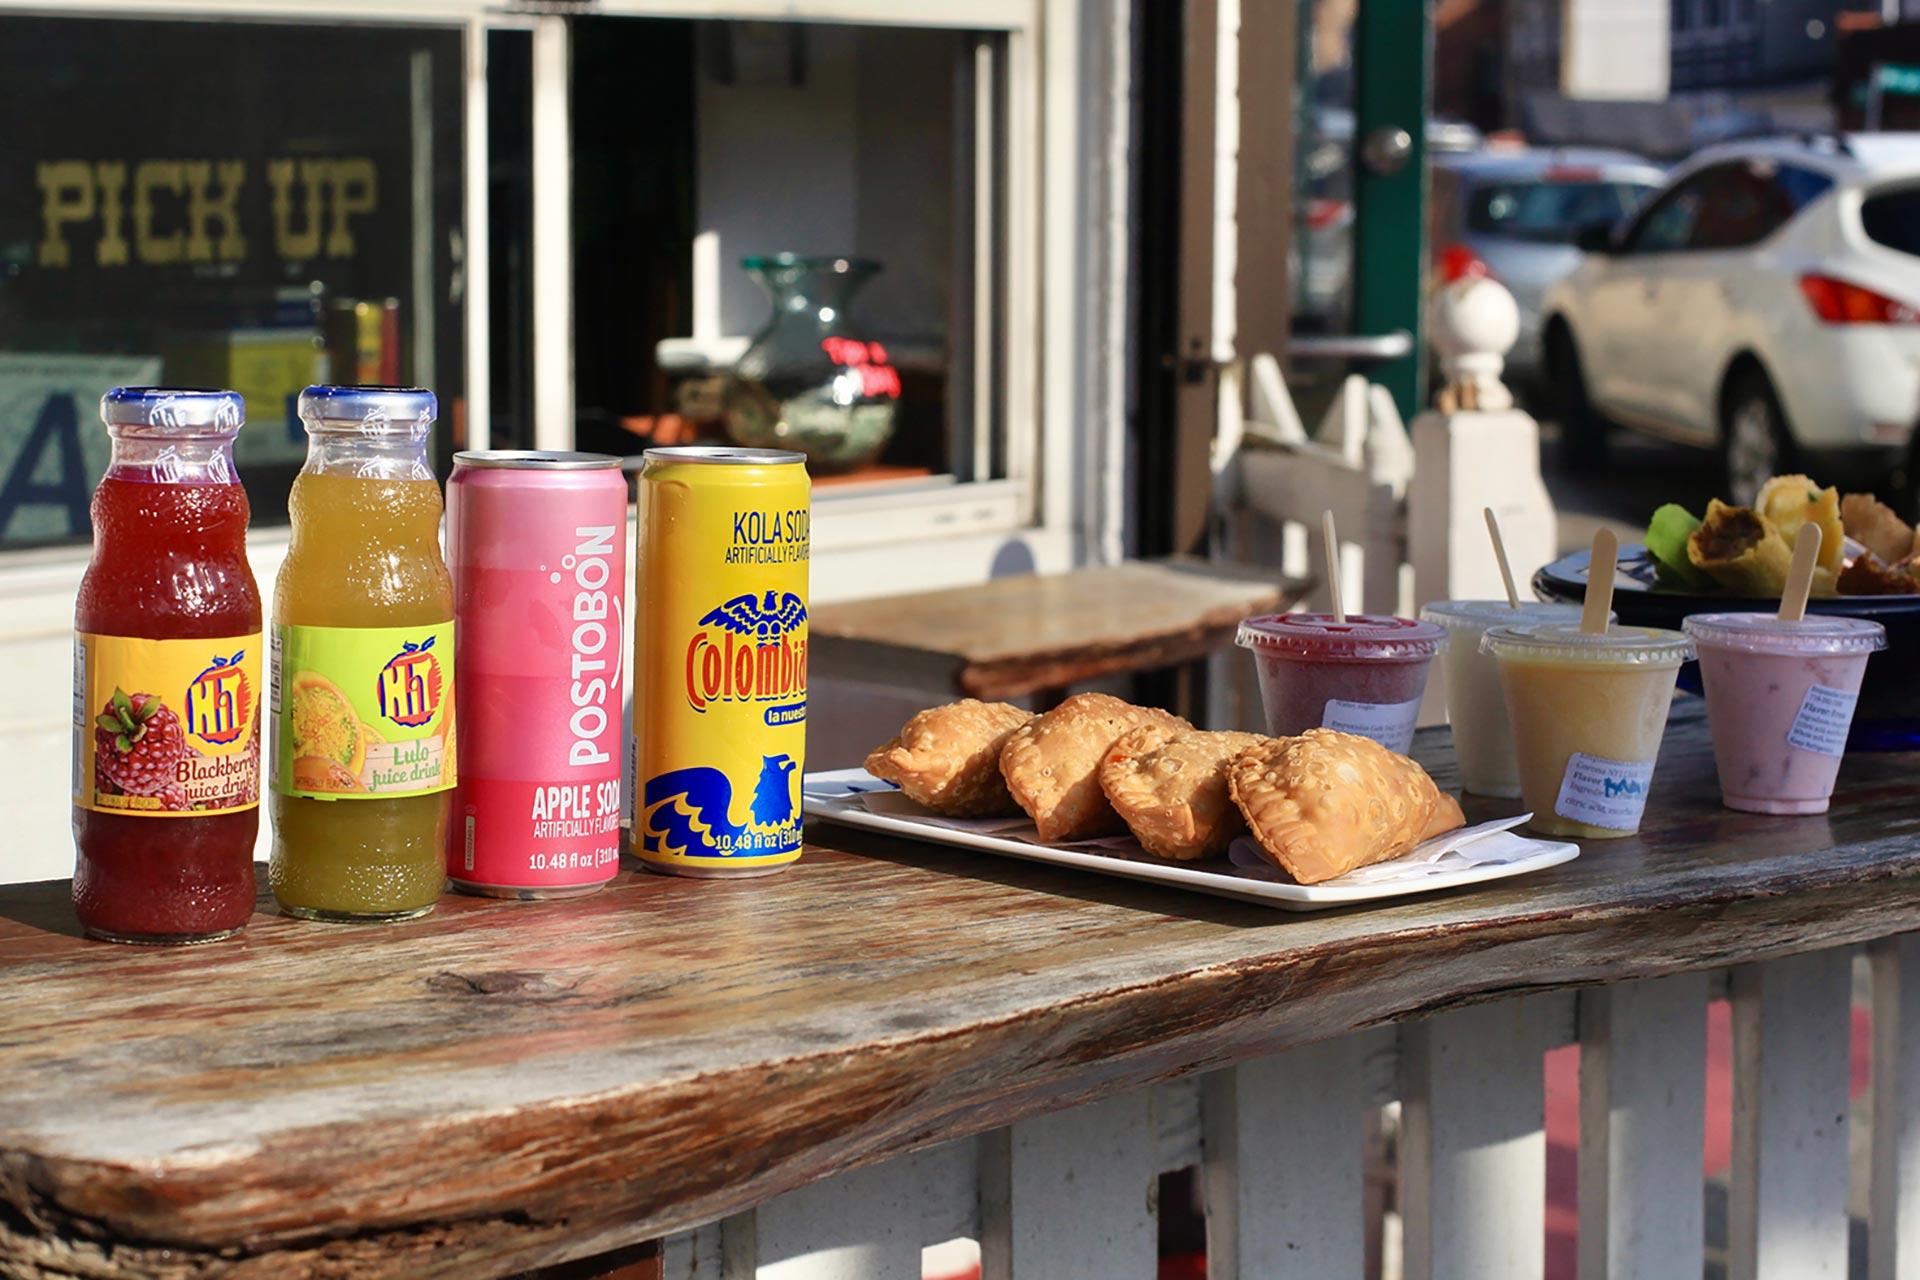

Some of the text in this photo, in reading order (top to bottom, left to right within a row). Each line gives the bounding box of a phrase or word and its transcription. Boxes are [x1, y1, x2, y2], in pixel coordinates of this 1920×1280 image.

[37, 157, 378, 266] PICK UP
[0, 388, 92, 538] A
[733, 511, 783, 545] KOLA
[725, 546, 787, 564] ARTIFICIALLY
[686, 631, 807, 710] Colombia
[768, 710, 780, 723] la
[394, 739, 430, 766] Lulo
[369, 769, 408, 792] juice
[410, 757, 441, 782] drink
[183, 782, 221, 803] juice
[531, 785, 591, 820] APPLE
[533, 818, 595, 838] ARTIFICIALLY
[715, 834, 752, 850] 10.48
[764, 835, 777, 848] oz
[529, 853, 567, 870] 10.48
[569, 852, 578, 868] fl
[580, 854, 593, 868] oz
